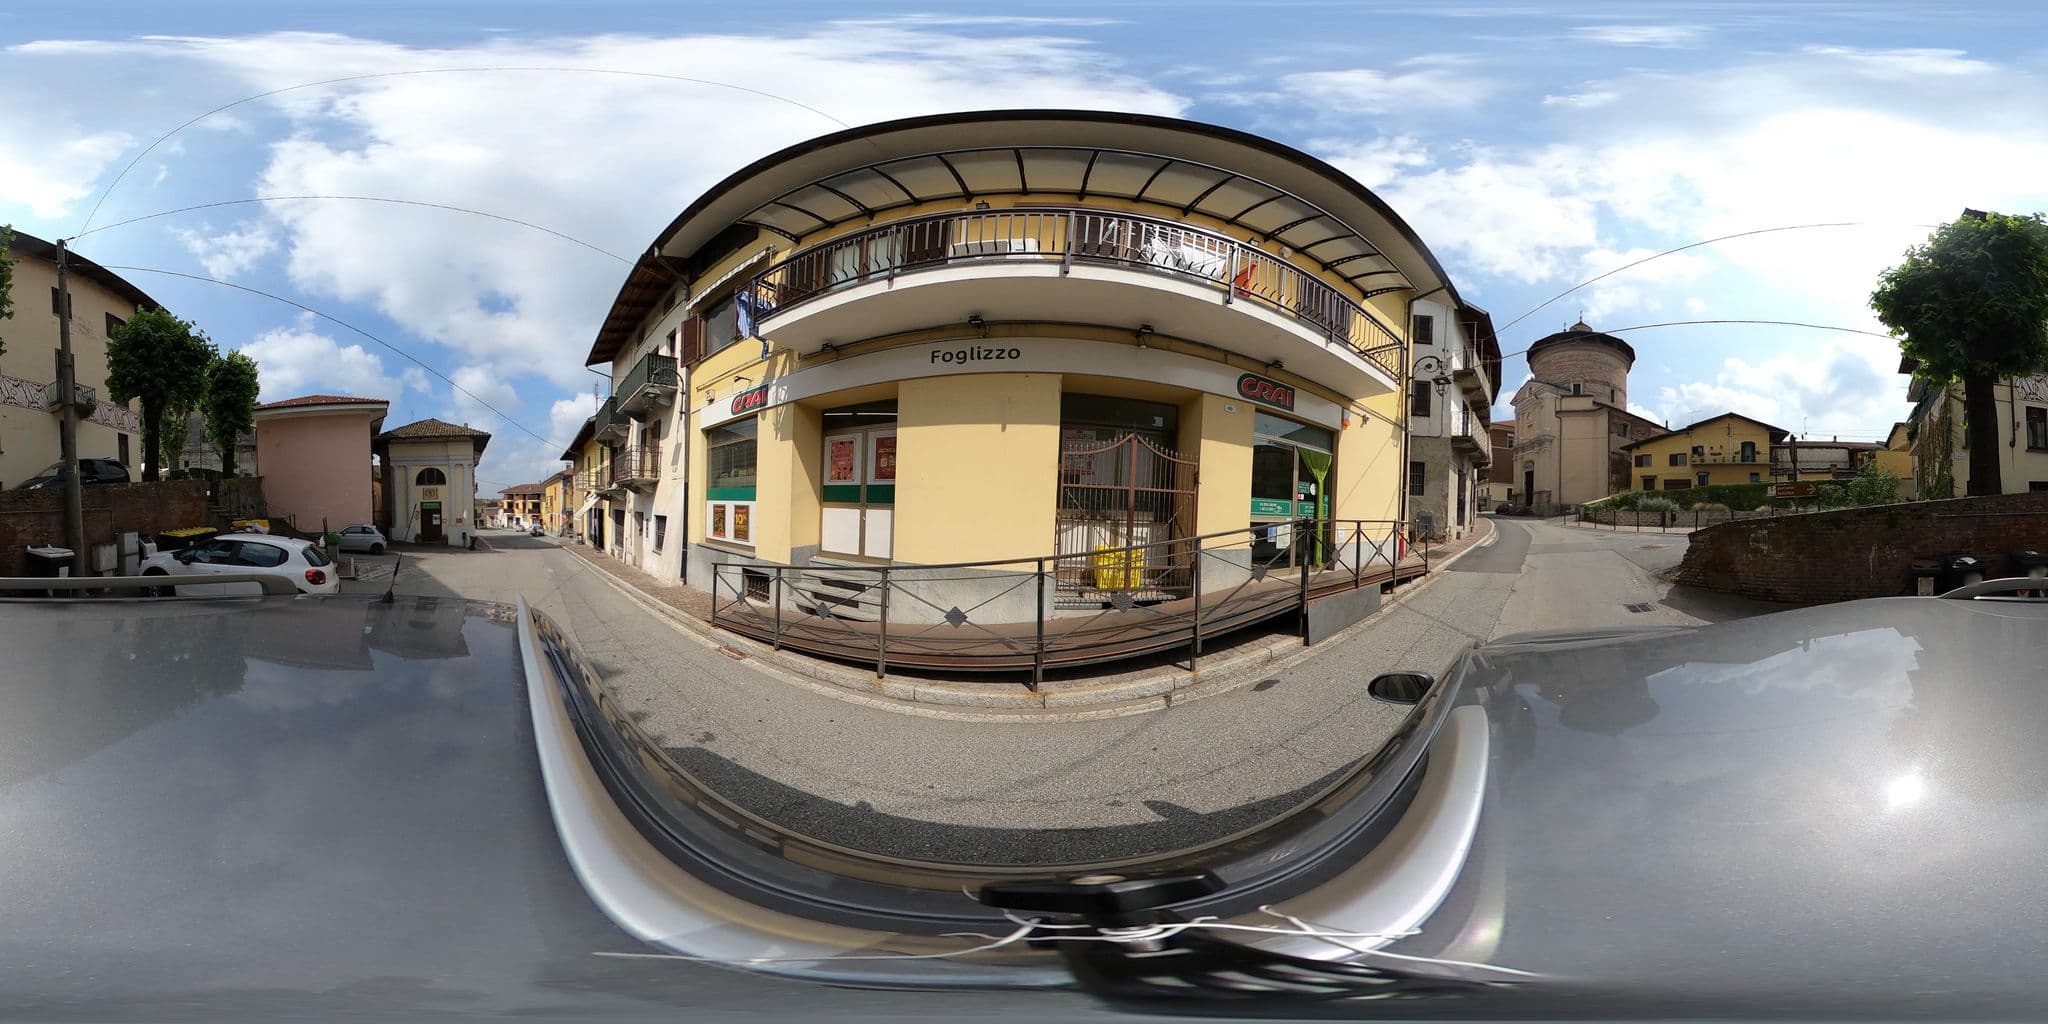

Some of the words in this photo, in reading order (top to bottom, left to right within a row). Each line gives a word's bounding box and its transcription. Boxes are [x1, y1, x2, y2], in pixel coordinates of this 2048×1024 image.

[931, 346, 1021, 364] Foglizzo
[732, 389, 768, 413] CRAI
[1241, 377, 1292, 407] CRAI
